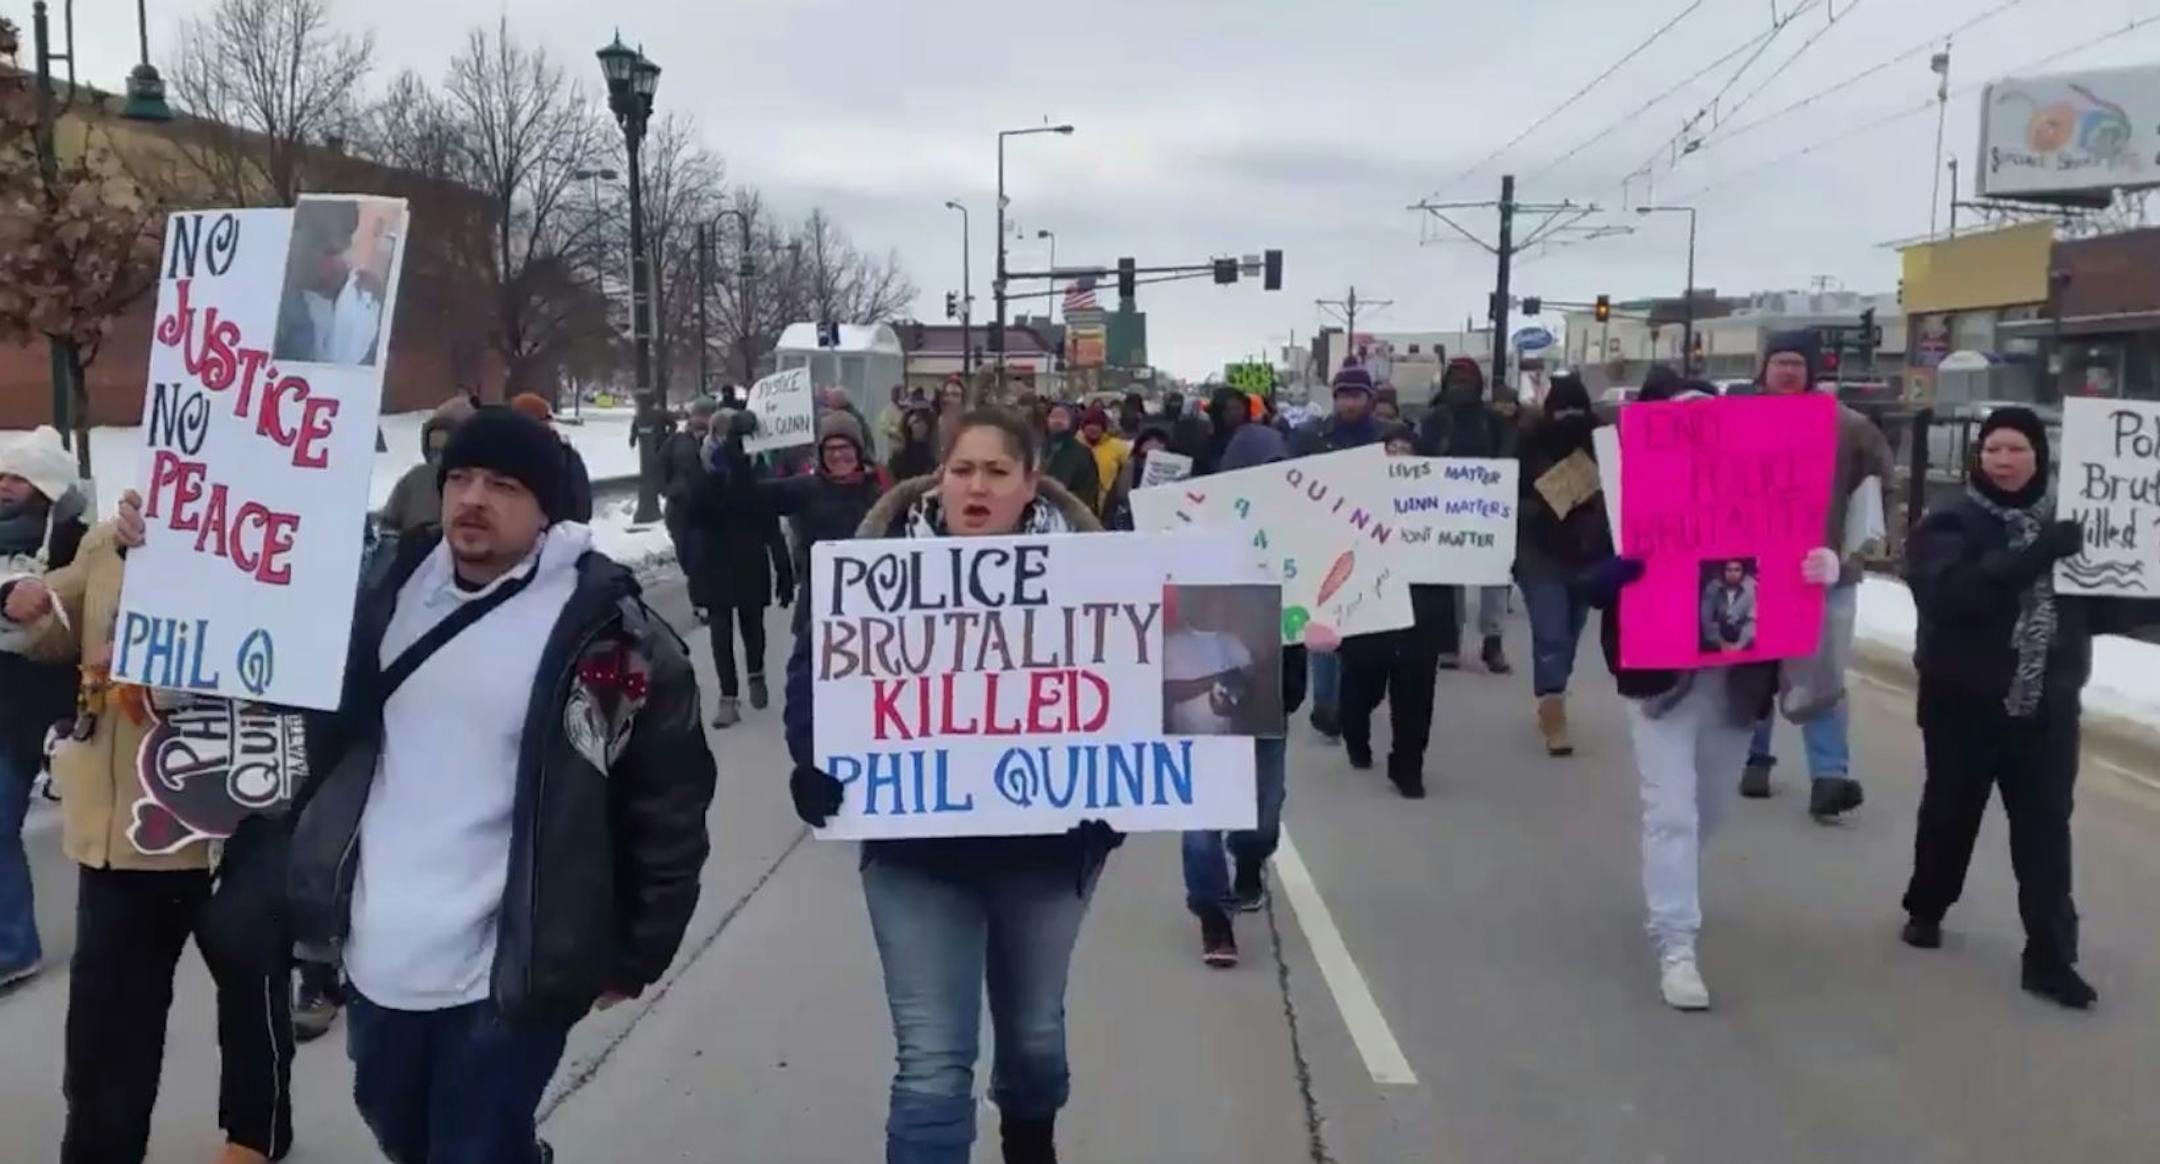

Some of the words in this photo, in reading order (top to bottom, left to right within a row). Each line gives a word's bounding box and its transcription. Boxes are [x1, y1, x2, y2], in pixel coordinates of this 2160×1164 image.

[168, 213, 240, 279] NO
[148, 383, 210, 455] NO
[776, 414, 810, 435] QUINN
[1646, 409, 1720, 448] END
[1286, 468, 1392, 544] QUINN
[1389, 462, 1432, 479] LIVES
[1444, 466, 1502, 485] MATTER
[1394, 497, 1438, 514] UINN
[145, 450, 300, 585] PEACE
[830, 545, 1049, 616] POLICE
[818, 603, 1160, 681] BRUTALITY
[872, 669, 1111, 740] KILLED
[827, 749, 973, 815] PHIL
[993, 740, 1193, 808] QUINN
